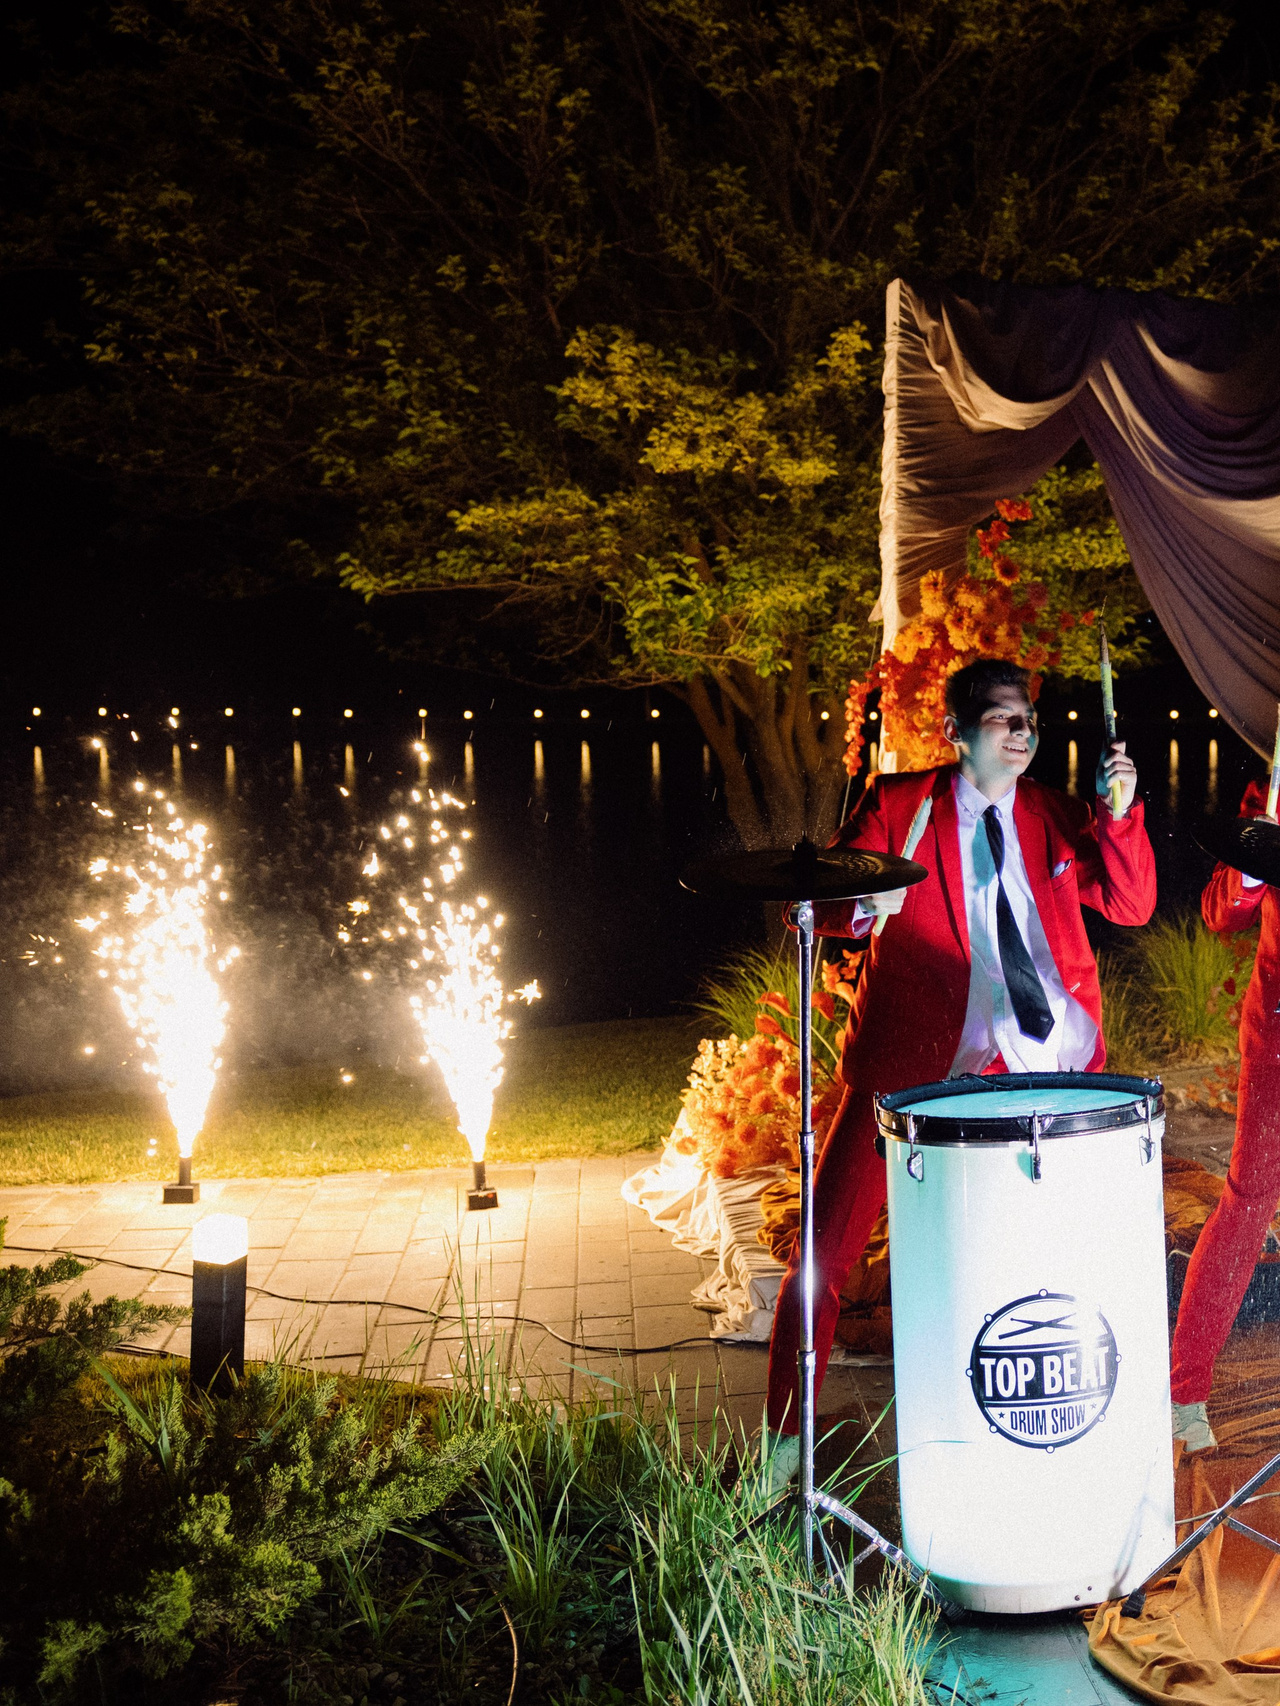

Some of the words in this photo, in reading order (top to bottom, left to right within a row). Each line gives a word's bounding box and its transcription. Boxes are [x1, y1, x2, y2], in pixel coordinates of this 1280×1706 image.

[979, 1356, 1036, 1397] TOP
[1043, 1346, 1110, 1395] BEAT
[1010, 1406, 1047, 1436] DRUM
[1051, 1404, 1086, 1434] SHOW
